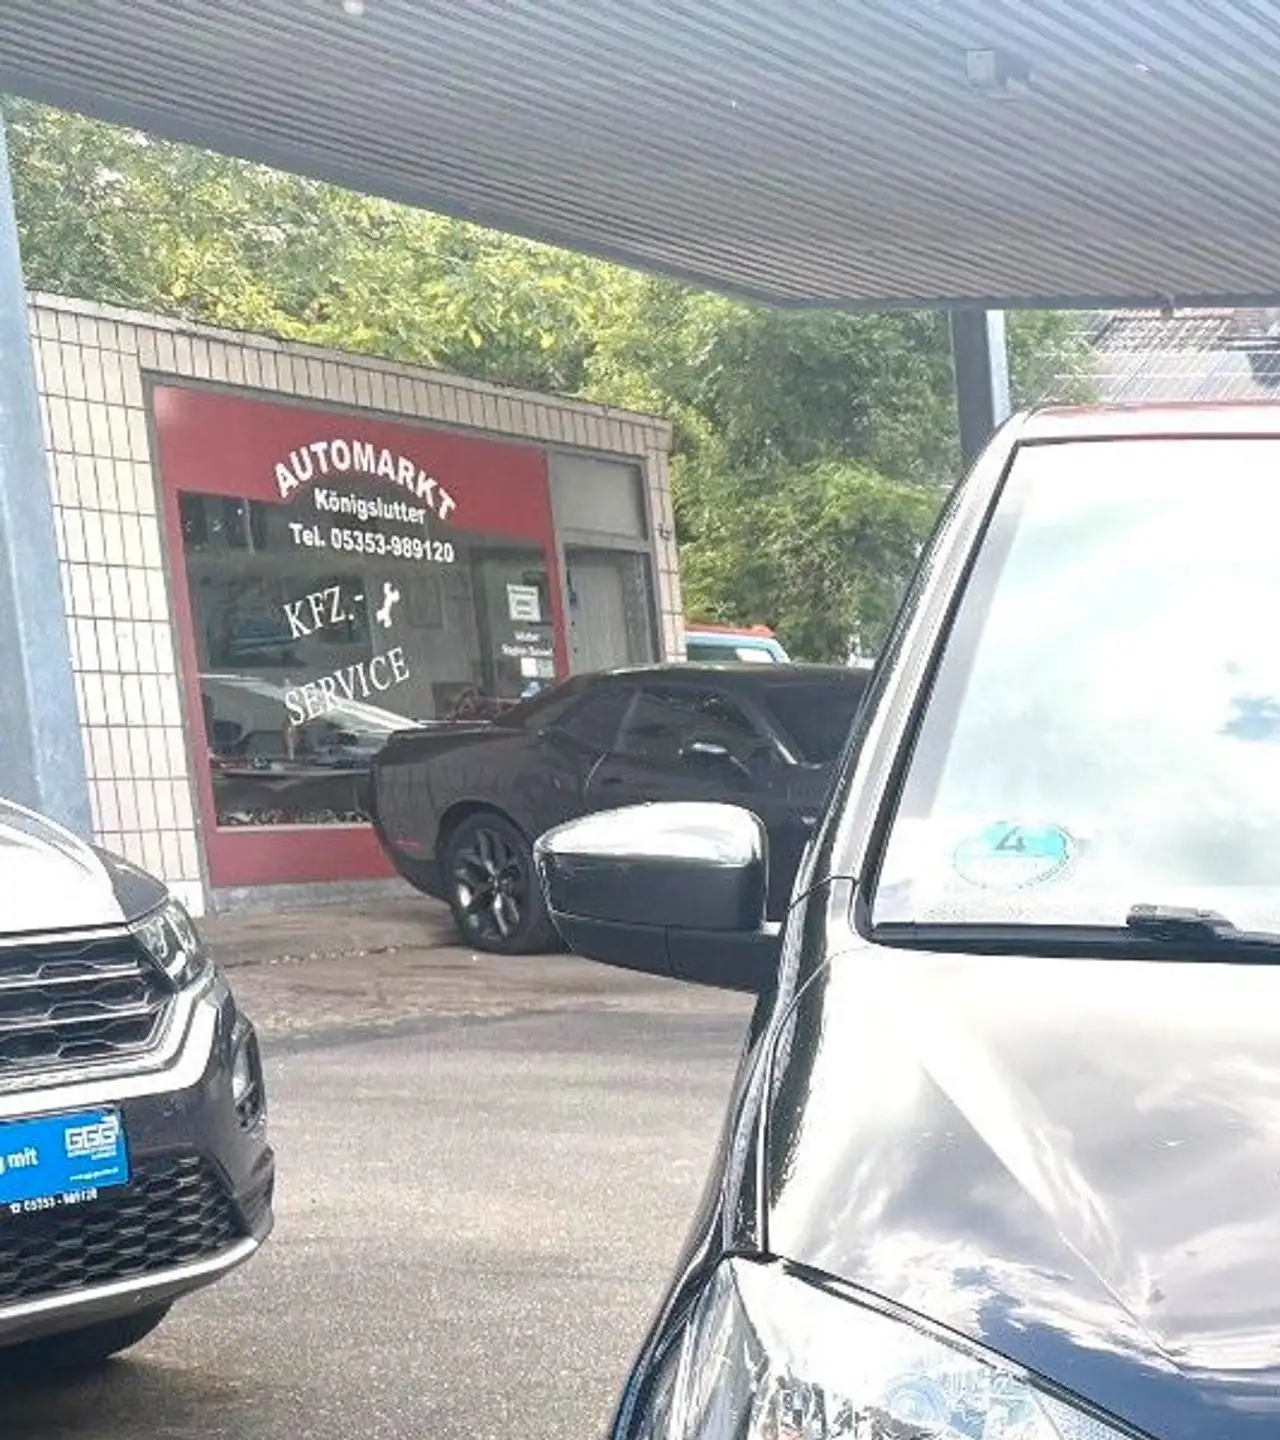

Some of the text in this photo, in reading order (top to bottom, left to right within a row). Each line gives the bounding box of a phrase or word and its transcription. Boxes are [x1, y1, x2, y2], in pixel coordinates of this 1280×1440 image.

[275, 439, 457, 520] AUTOMARKT
[314, 487, 427, 525] Königslutter
[288, 522, 456, 563] Tel. 05353-989120
[284, 647, 410, 726] SERVICE
[995, 825, 1026, 852] 4
[8, 1146, 39, 1168] mit
